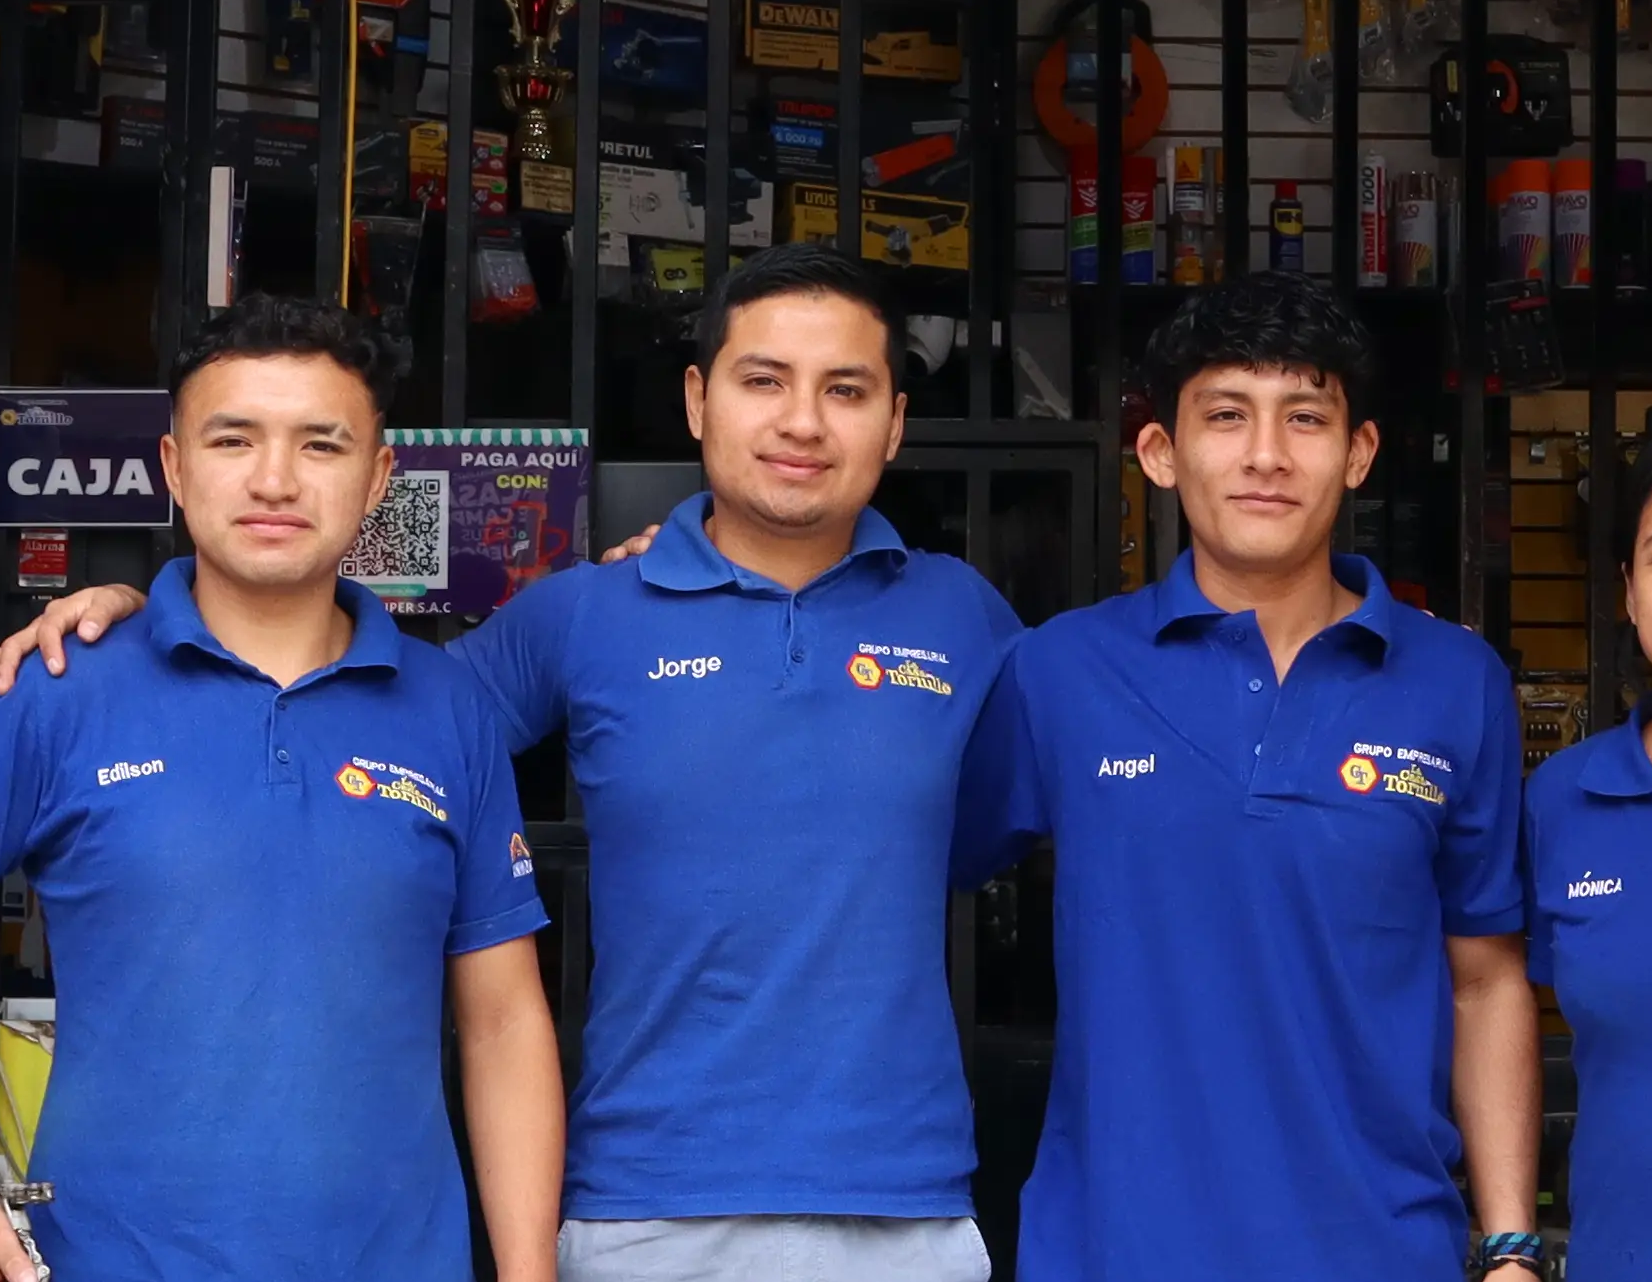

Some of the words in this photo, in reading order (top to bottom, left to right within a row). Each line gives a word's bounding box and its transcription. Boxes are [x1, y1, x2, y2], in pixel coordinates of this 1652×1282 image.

[1360, 166, 1375, 206] 1000
[804, 190, 876, 211] UYUSLS
[460, 452, 519, 468] PAGA
[523, 449, 578, 469] AQUÍ
[7, 457, 155, 497] CAJA
[496, 474, 548, 489] CON:
[24, 540, 66, 553] Alarma
[417, 602, 452, 614] S.A.C
[858, 643, 890, 656] GRUPO
[648, 656, 722, 680] Jorge
[885, 668, 953, 696] Tornillo
[1353, 742, 1392, 759] GRUPO
[97, 758, 164, 787] Edilson
[352, 756, 387, 772] GRUPO
[1098, 753, 1155, 779] Angel
[377, 783, 448, 822] Tornillo
[1568, 871, 1623, 900] MÓNICA
